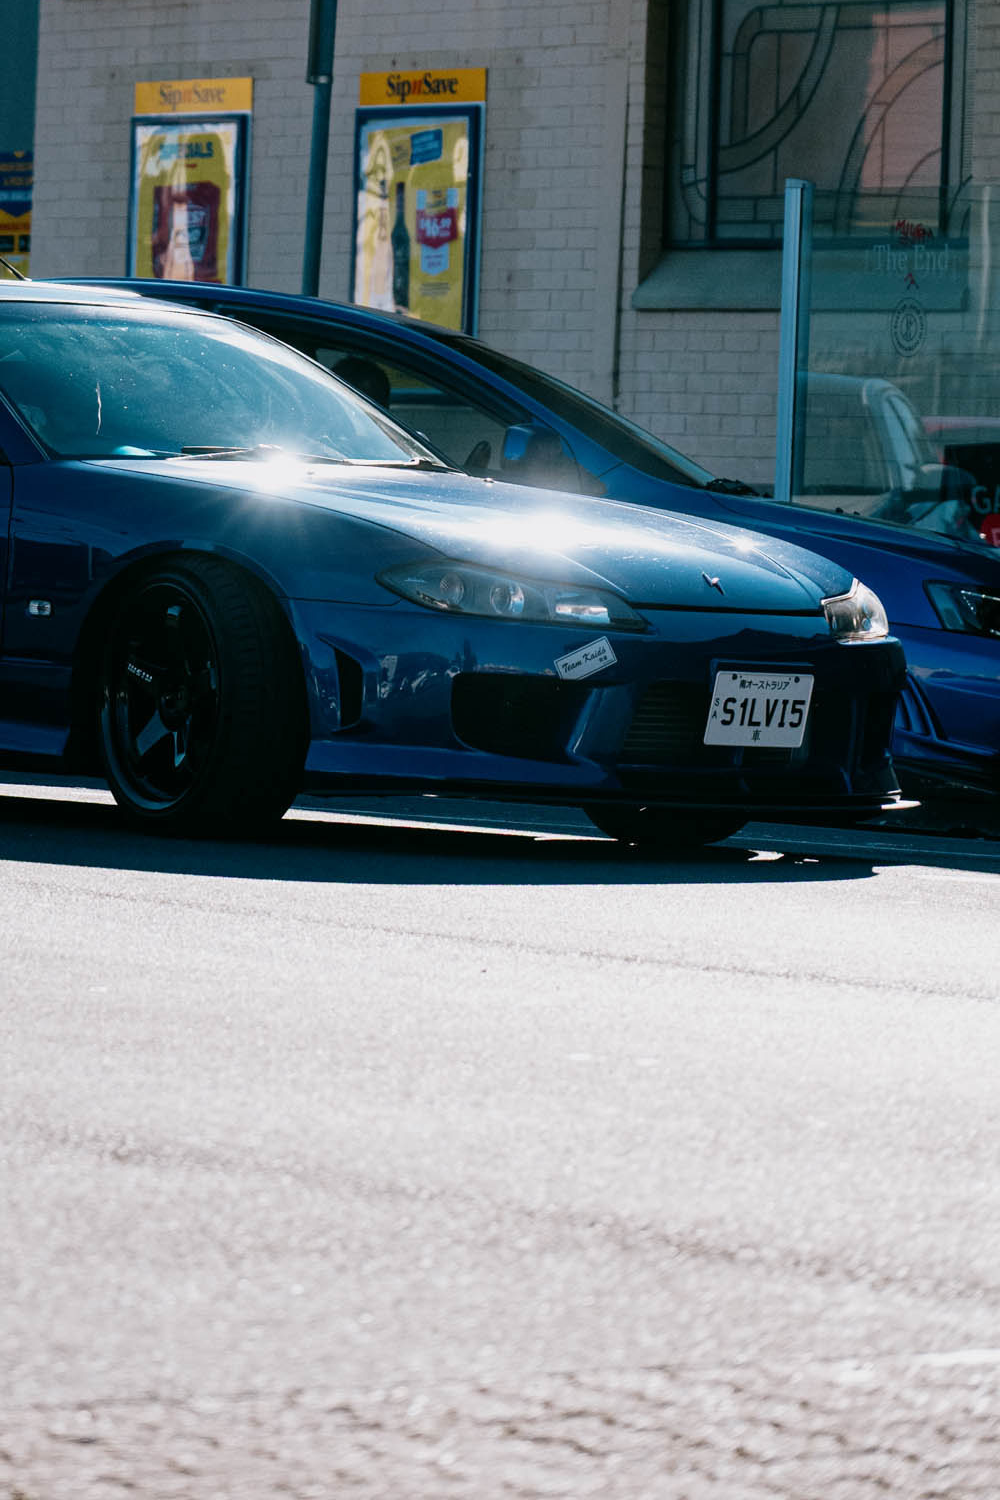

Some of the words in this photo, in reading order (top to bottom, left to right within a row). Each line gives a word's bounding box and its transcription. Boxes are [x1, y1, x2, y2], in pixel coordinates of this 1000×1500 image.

[873, 244, 908, 271] The
[914, 243, 949, 271] End
[562, 661, 582, 673] Team
